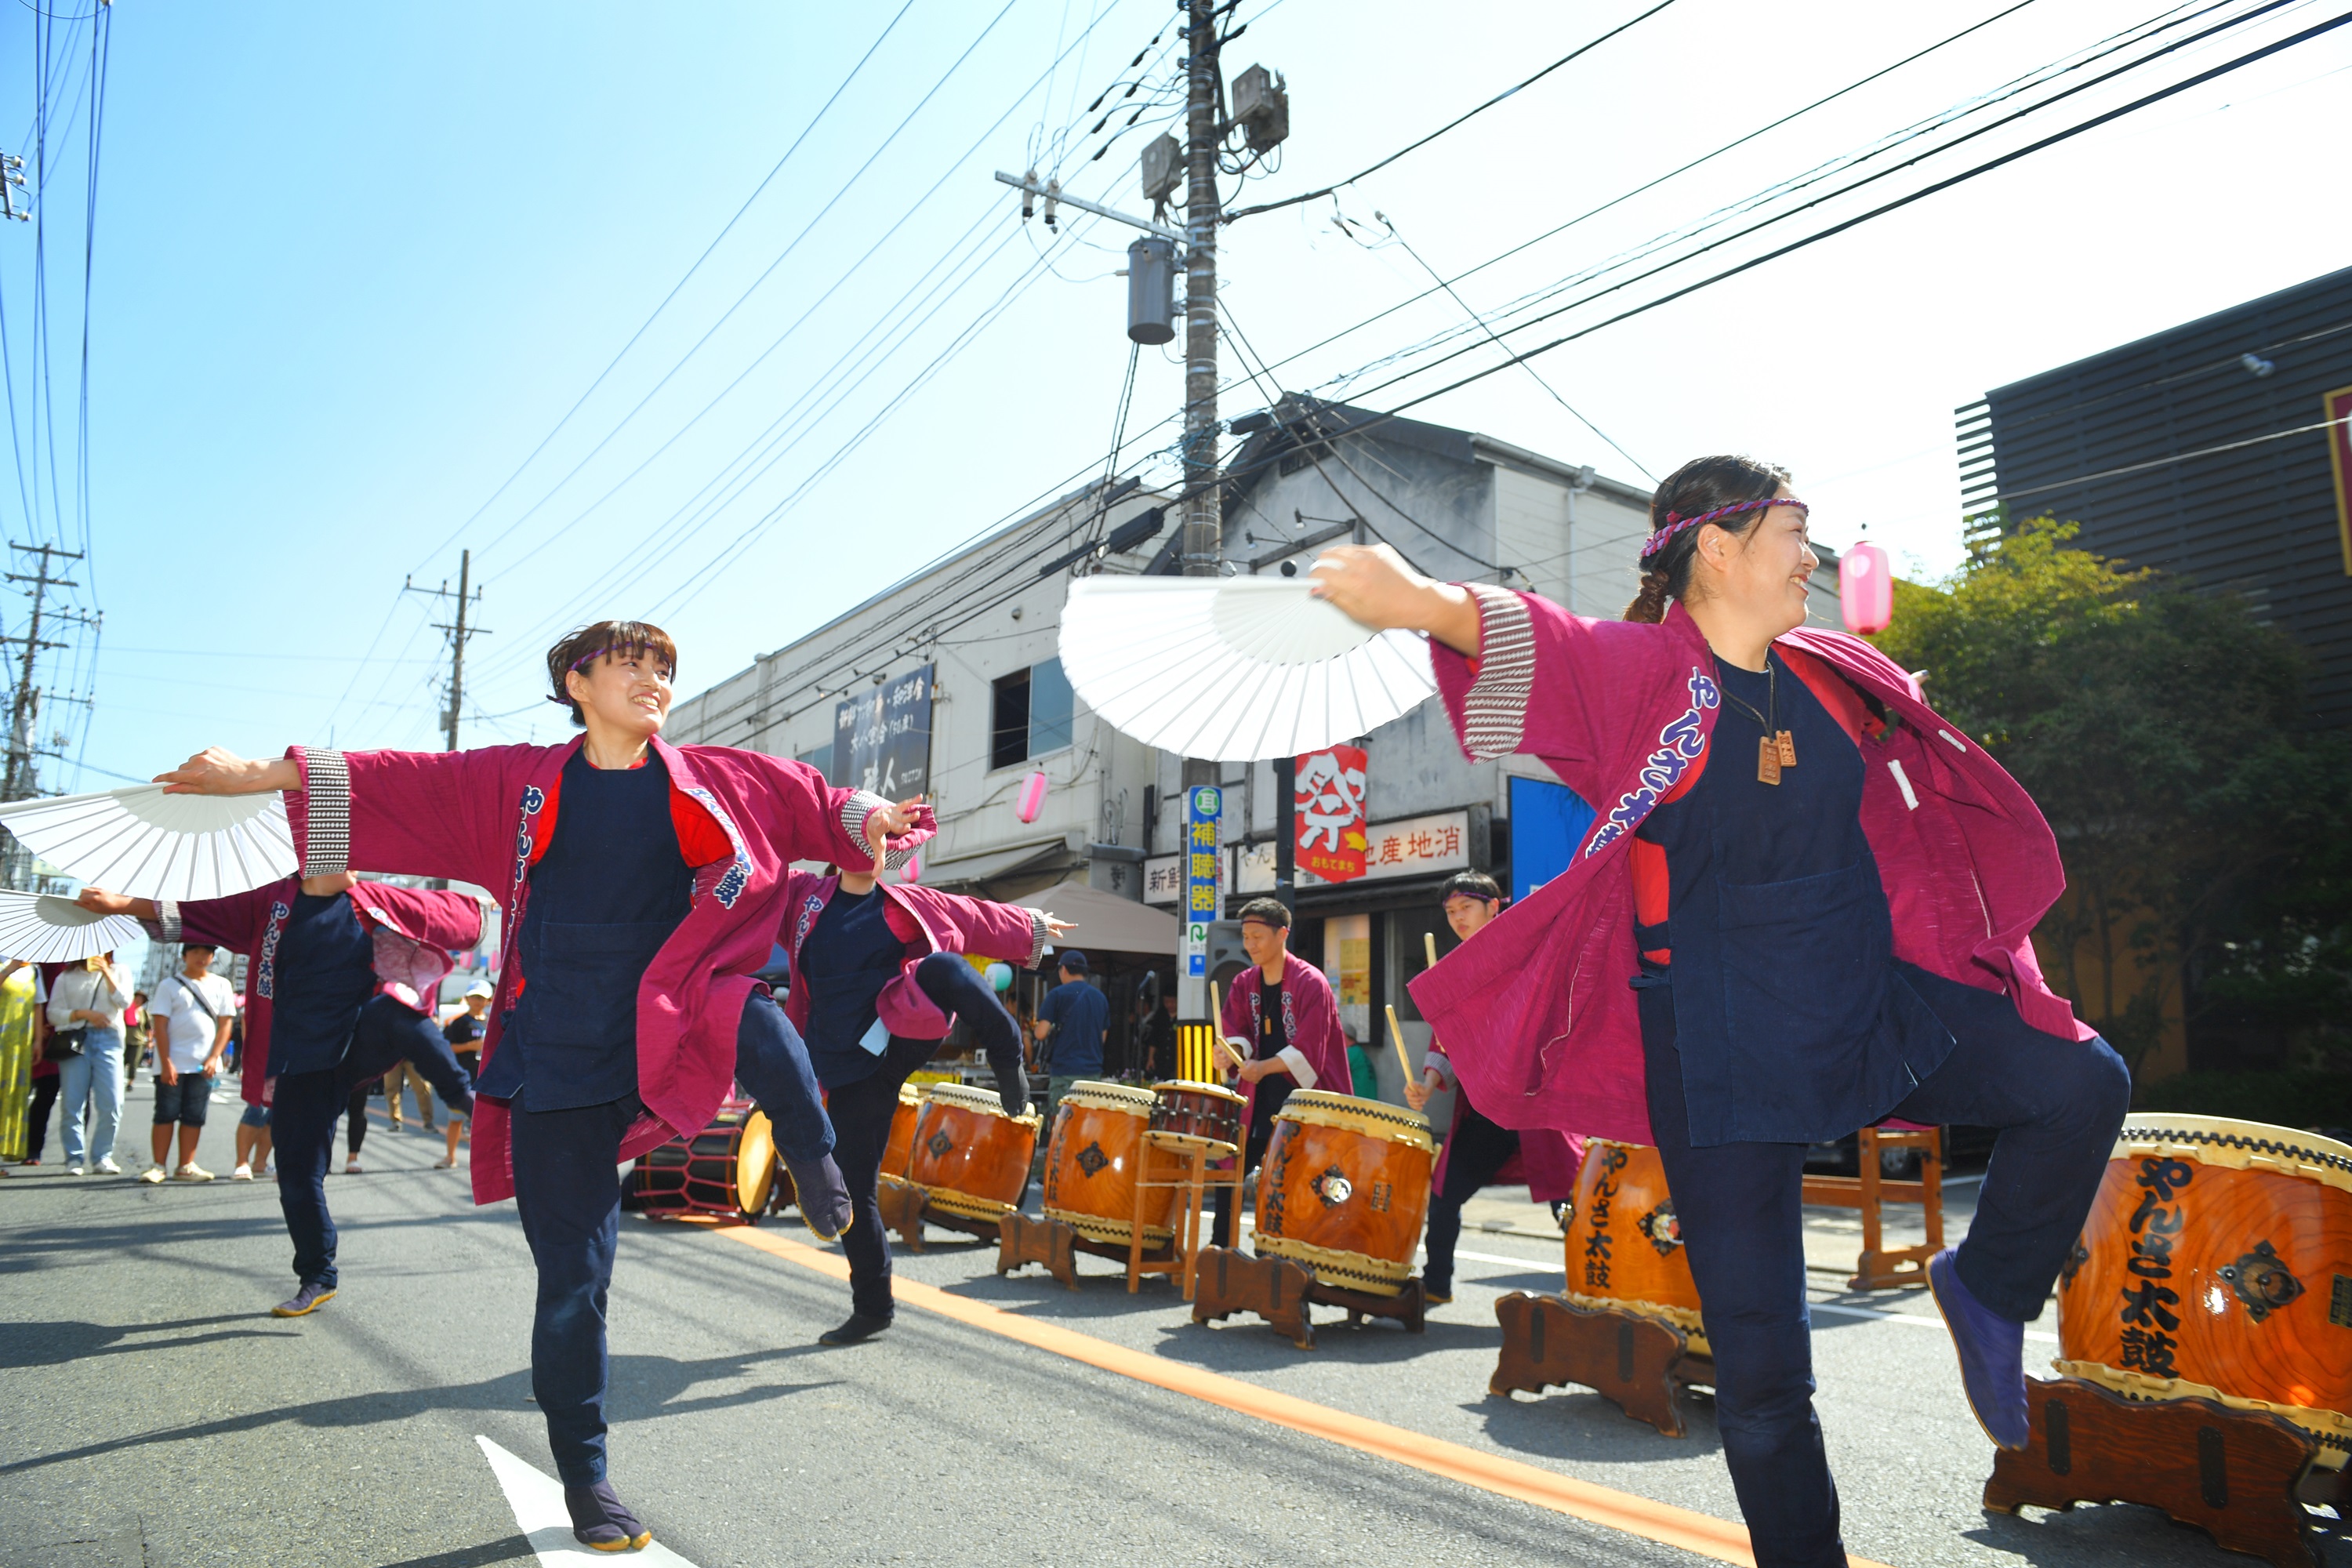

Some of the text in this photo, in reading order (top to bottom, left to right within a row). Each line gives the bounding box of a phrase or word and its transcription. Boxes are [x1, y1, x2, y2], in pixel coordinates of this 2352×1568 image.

[1294, 751, 1367, 853] 祭
[1191, 820, 1215, 911] 補聴器
[1311, 855, 1356, 873] おもてまち
[256, 900, 290, 1000] やんさ太鼓
[1264, 1121, 1302, 1236] やんさ太鼓
[1584, 1148, 1628, 1290] やんさ太鼓
[2119, 1156, 2194, 1379] やんさ太鼓
